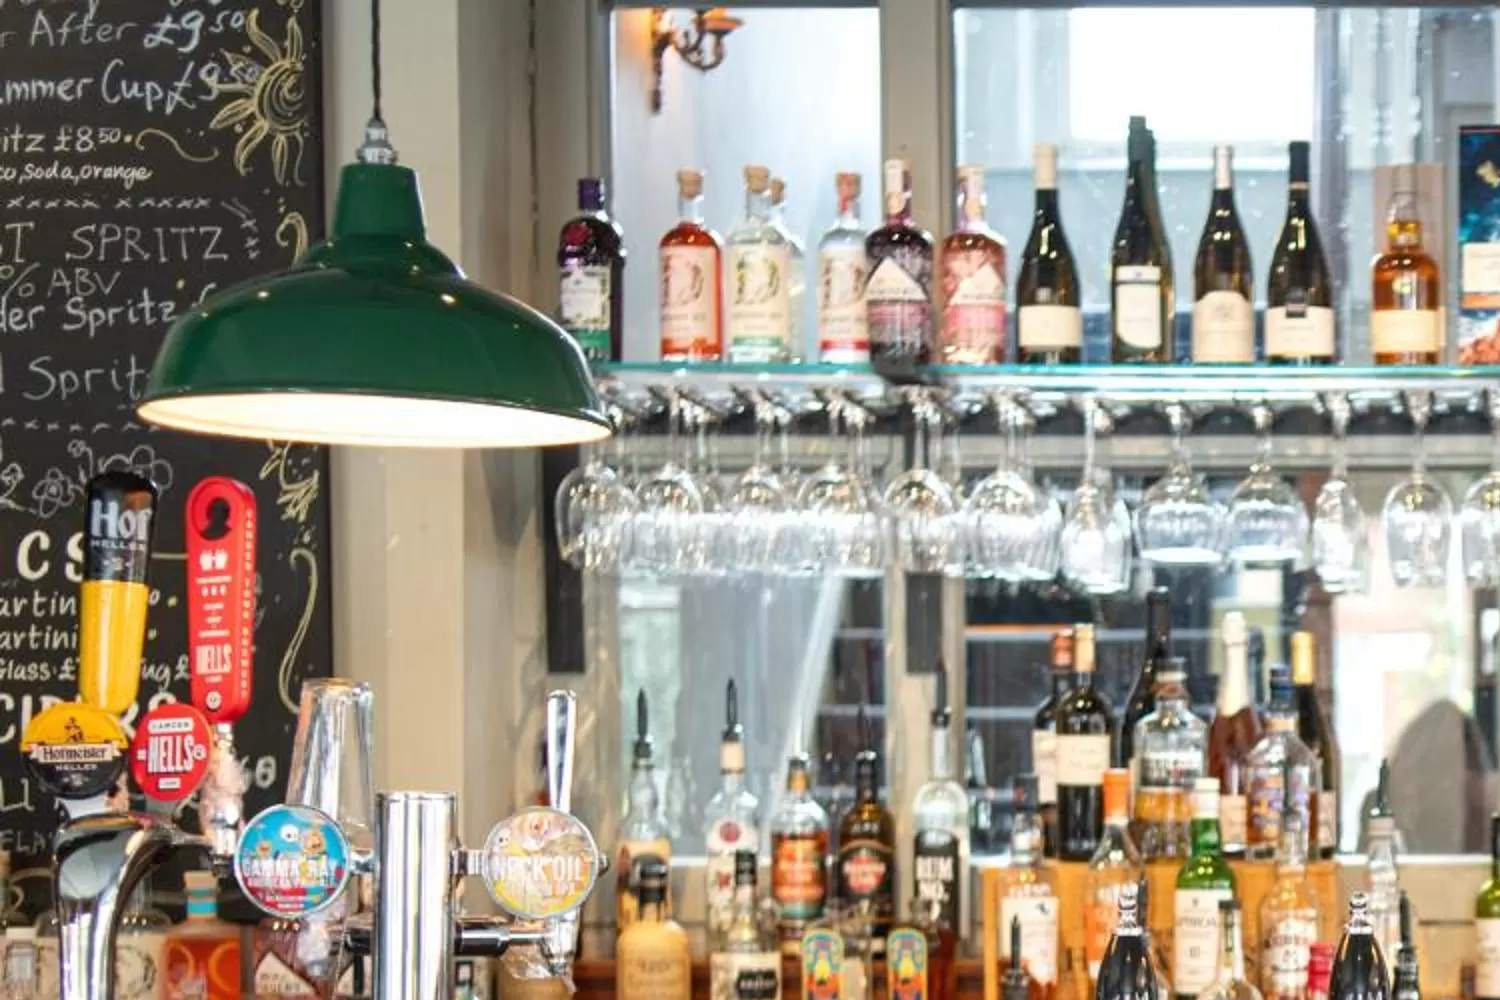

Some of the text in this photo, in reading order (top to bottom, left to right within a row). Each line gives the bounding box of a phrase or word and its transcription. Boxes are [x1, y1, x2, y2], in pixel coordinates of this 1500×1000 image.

[30, 9, 138, 47] After
[101, 58, 163, 112] Cup
[65, 224, 229, 263] SPRITZ
[48, 267, 121, 297] ABV
[62, 288, 178, 339] Spritz
[22, 354, 151, 401] Sprit
[0, 590, 77, 618] artin
[196, 645, 232, 674] HELLS
[148, 734, 195, 773] HELLS
